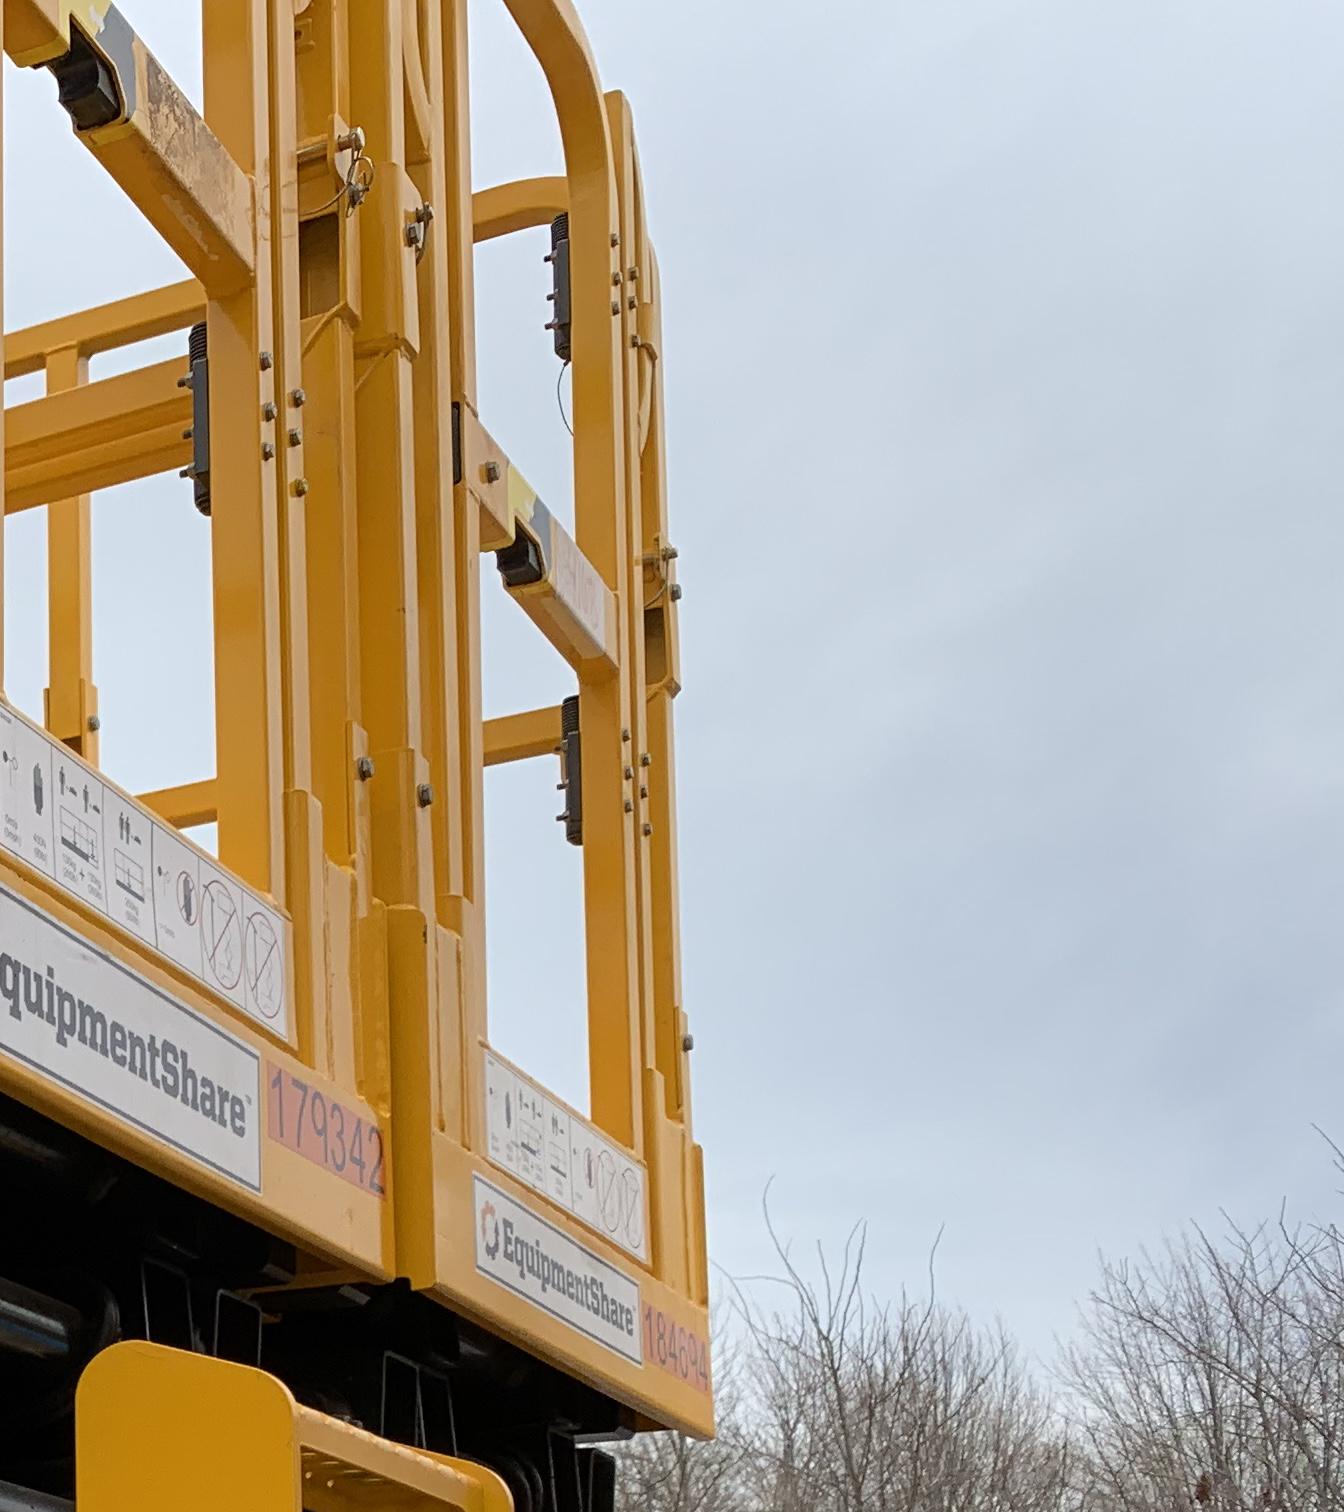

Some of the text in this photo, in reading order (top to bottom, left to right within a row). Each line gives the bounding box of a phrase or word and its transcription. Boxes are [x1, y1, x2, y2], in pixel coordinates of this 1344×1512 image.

[269, 1066, 386, 1198] 179342
[502, 1218, 634, 1337] EquipmentShare
[644, 1305, 709, 1392] 184694
